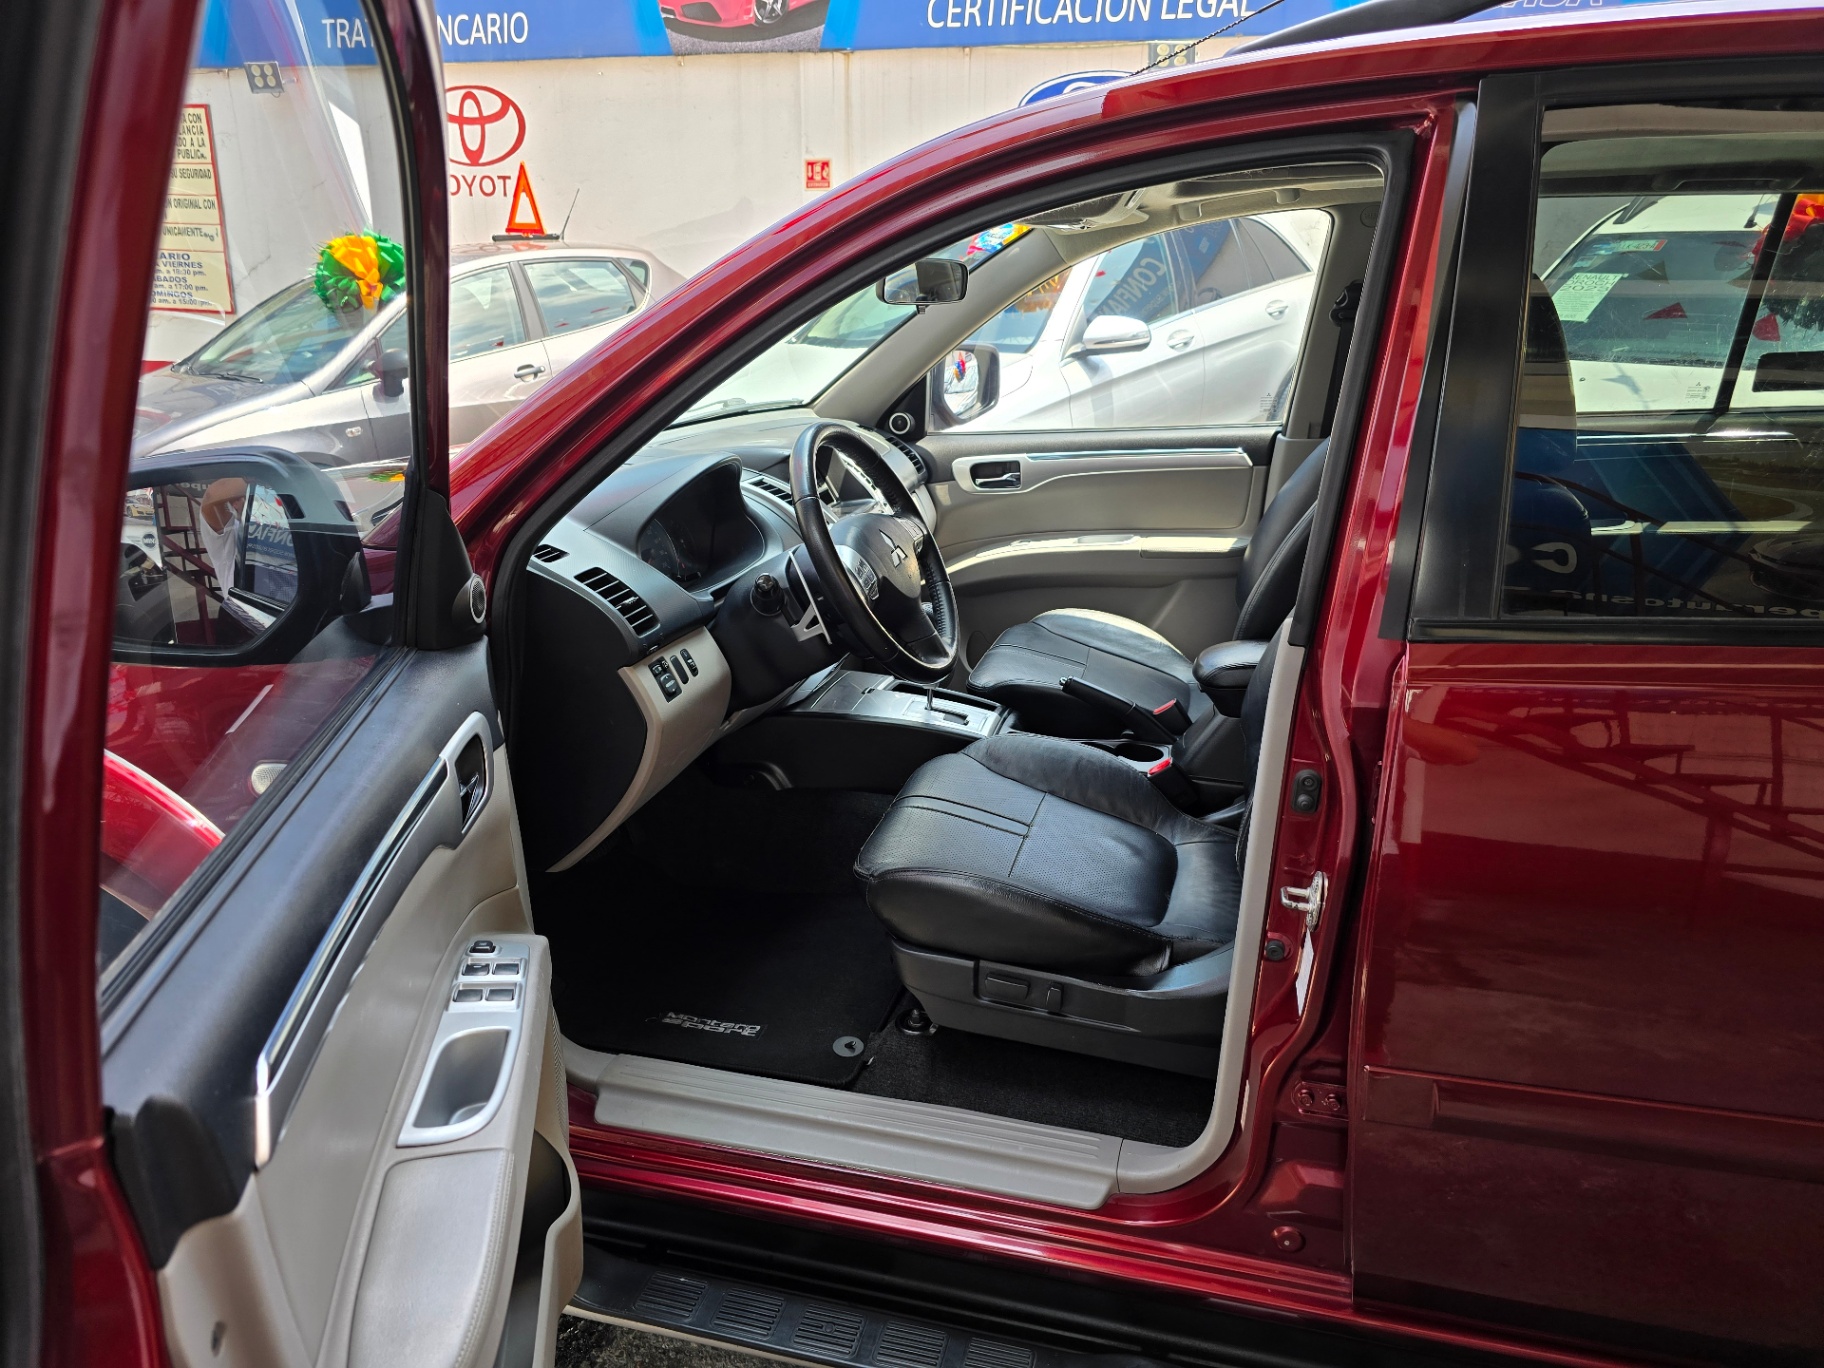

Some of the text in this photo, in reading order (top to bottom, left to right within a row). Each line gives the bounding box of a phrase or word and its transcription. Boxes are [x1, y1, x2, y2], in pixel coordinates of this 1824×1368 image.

[1160, 0, 1257, 20] LEGAL
[436, 10, 529, 46] NCARIO
[188, 113, 202, 124] CON
[179, 124, 204, 136] ANCIA
[190, 136, 195, 148] A
[197, 136, 206, 148] LA
[179, 168, 211, 179] SEGURIDAD
[449, 174, 512, 197] OYOT
[173, 198, 202, 209] ORIGINAL
[203, 199, 216, 210] CON
[159, 252, 191, 261] ARIO
[162, 260, 203, 269] VIERNES
[153, 275, 188, 284] BADOS
[151, 289, 193, 298] OMINGOS
